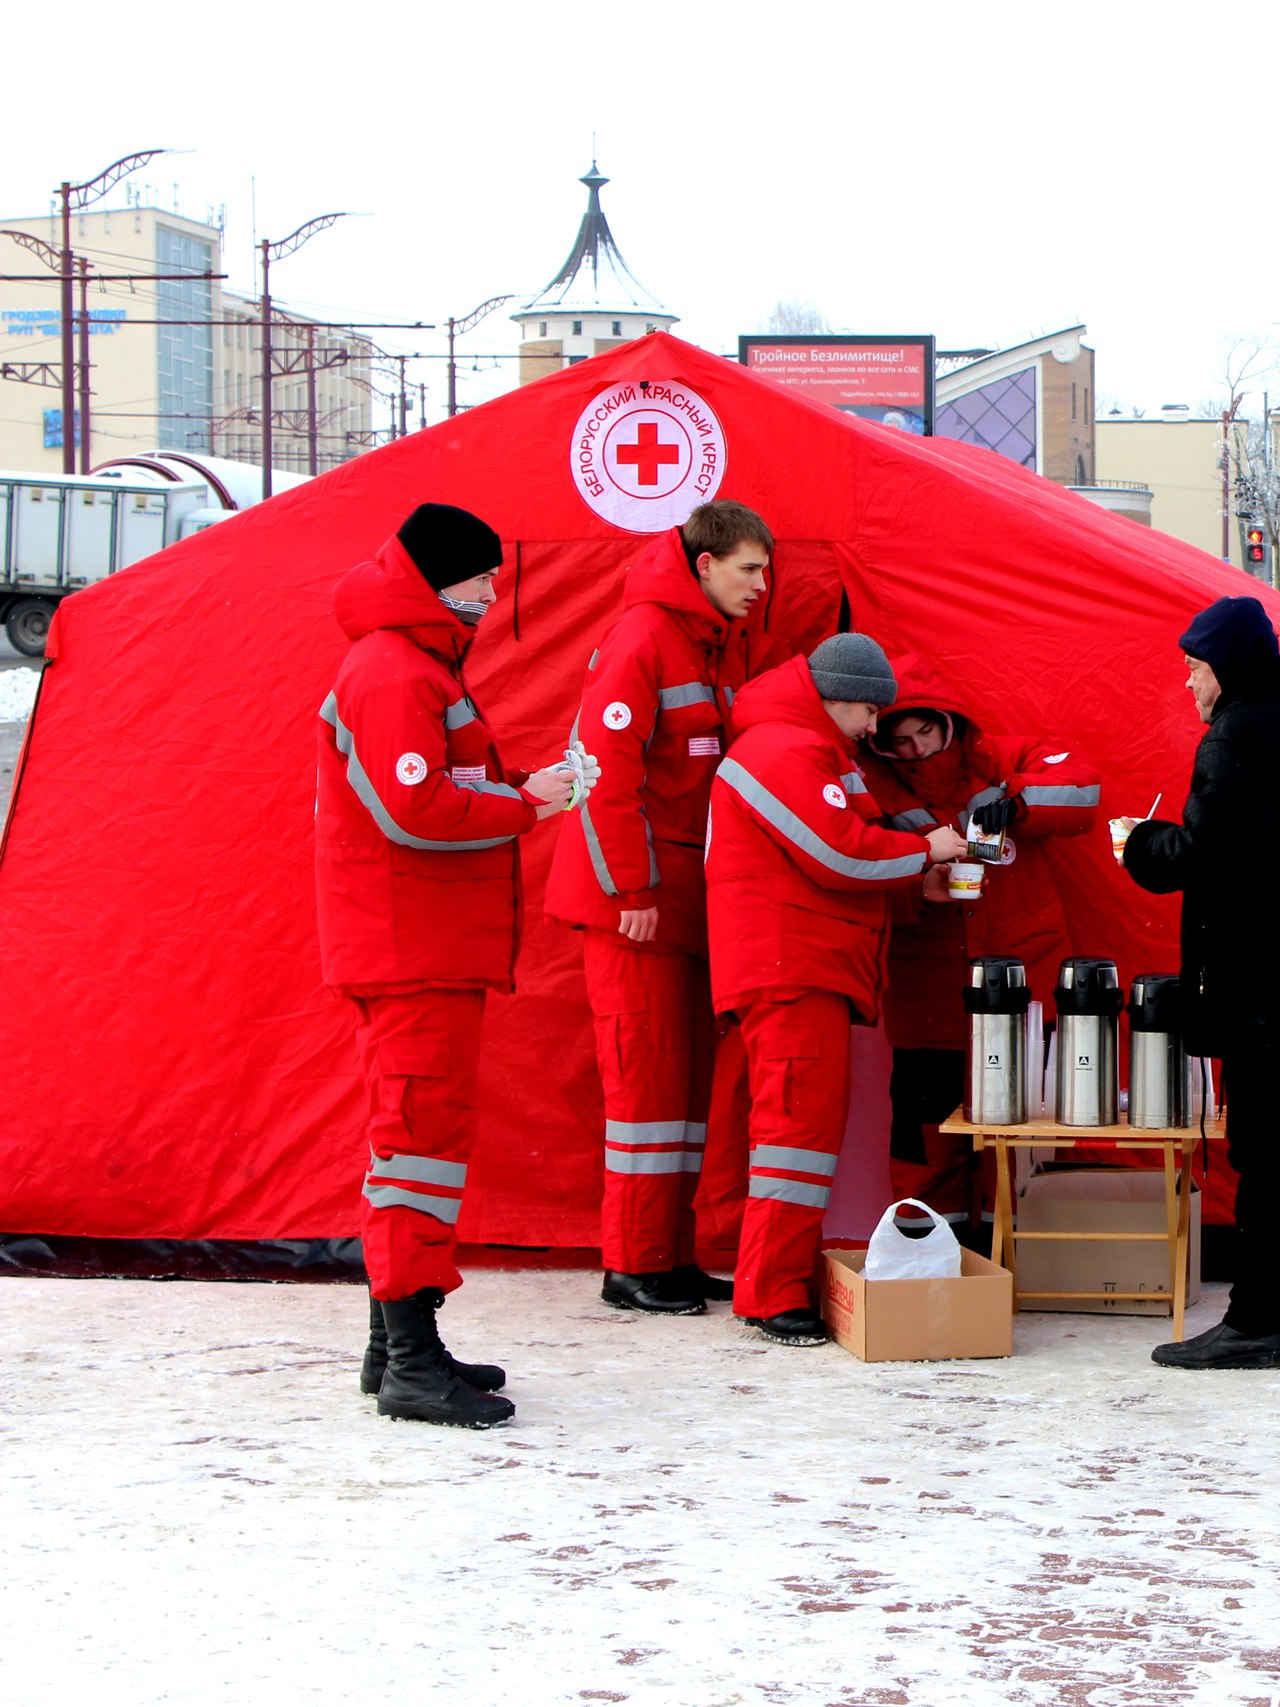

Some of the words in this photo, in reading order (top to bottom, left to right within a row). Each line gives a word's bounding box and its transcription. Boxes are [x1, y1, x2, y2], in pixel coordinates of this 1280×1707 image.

[752, 349, 807, 364] Тройное
[810, 349, 904, 363] Безлимитище!
[579, 385, 637, 498] БЕЛОРУССКИЙ
[642, 385, 714, 438] КРАСНЫЙ
[694, 442, 716, 497] КРЕСТ
